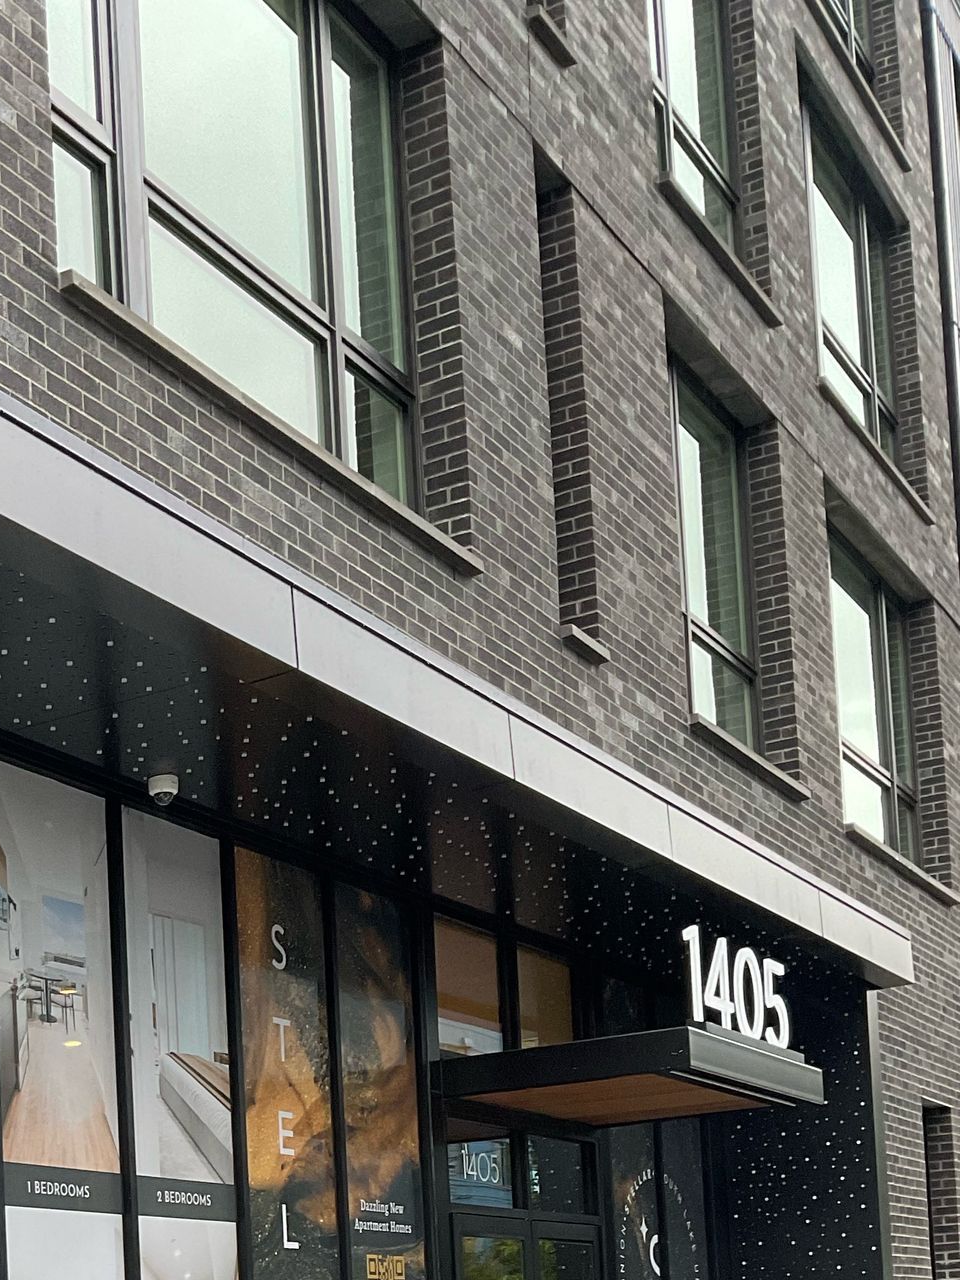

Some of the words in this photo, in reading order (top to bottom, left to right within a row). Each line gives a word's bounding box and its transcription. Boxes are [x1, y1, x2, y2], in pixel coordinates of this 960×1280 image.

[681, 924, 790, 1050] 1405
[461, 1144, 499, 1183] 1405
[26, 1181, 31, 1194] 1
[34, 1181, 90, 1198] BEDROOMS
[157, 1191, 163, 1202] 2
[164, 1191, 212, 1206] BEDROOMS
[360, 1199, 389, 1216] Dazzling
[390, 1202, 404, 1214] New
[354, 1218, 389, 1233] Apartment
[390, 1221, 412, 1233] Homes
